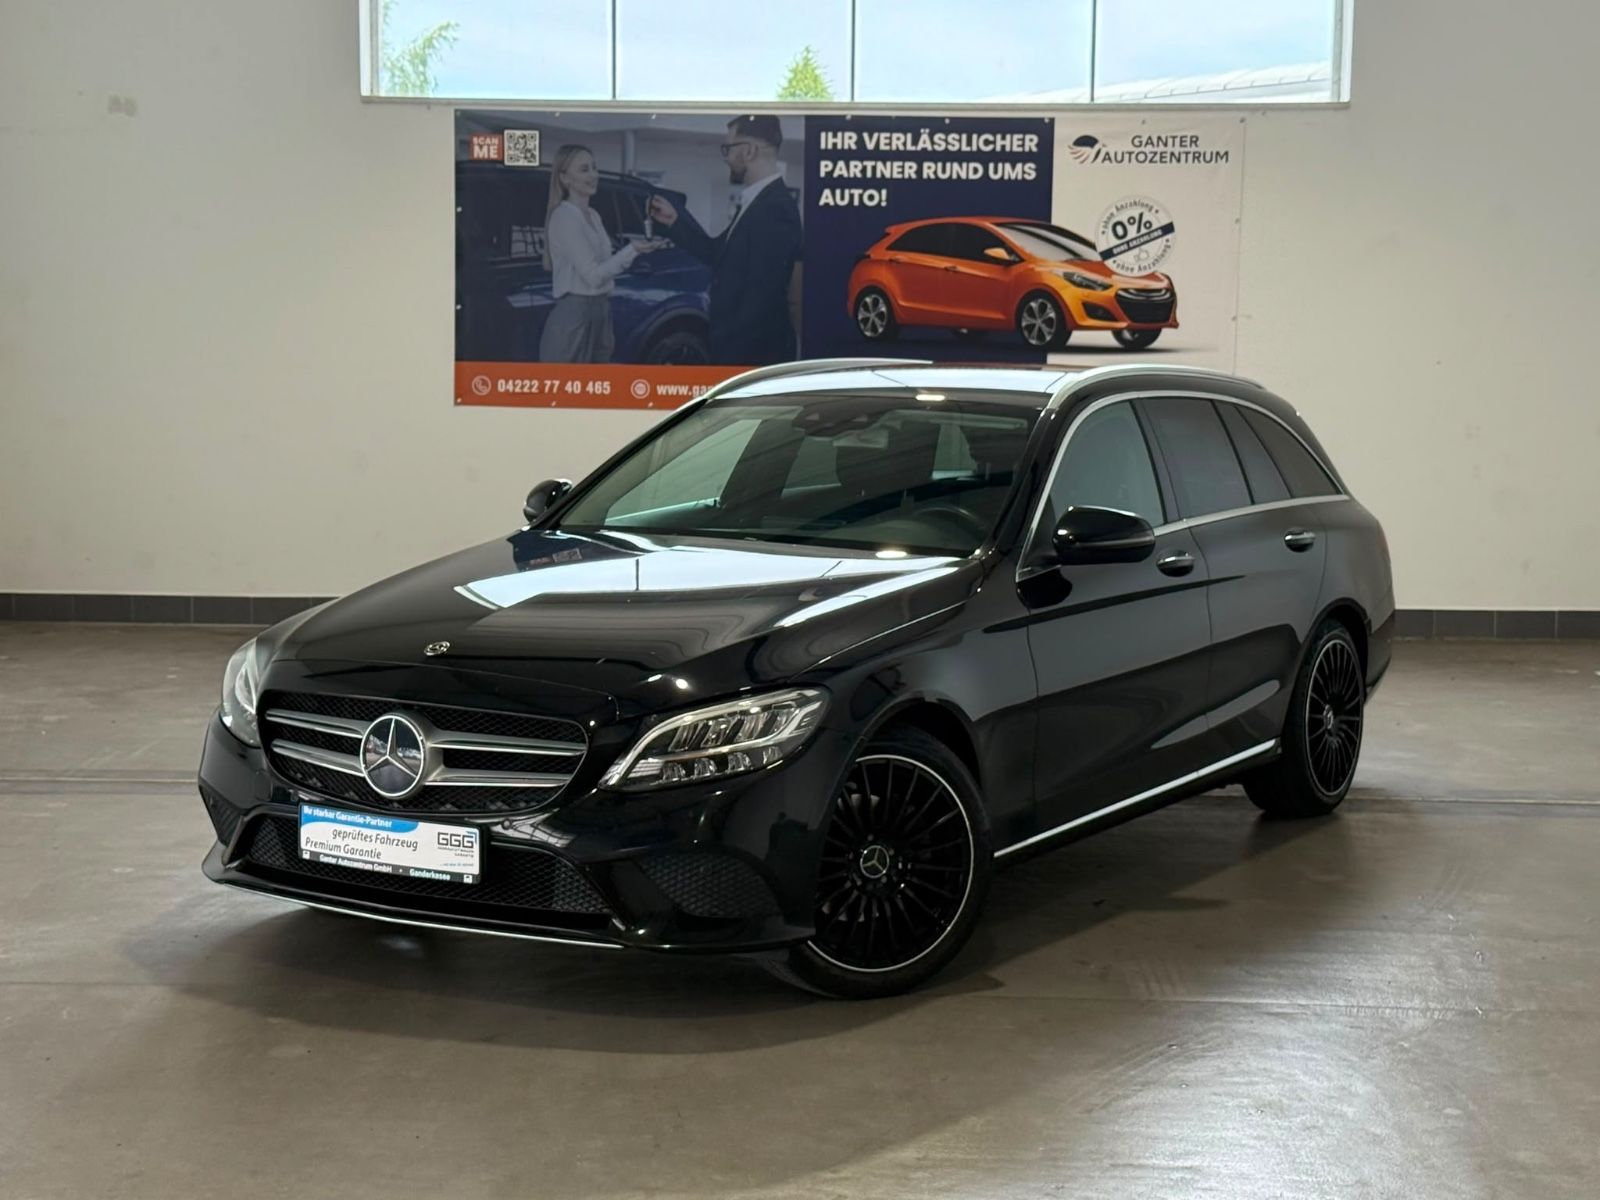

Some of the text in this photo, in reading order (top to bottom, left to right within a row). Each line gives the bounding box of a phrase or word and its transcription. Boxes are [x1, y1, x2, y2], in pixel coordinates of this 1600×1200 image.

[472, 135, 499, 145] SCAN
[819, 128, 1040, 154] IHR VERLÄSSLICHER
[1131, 134, 1200, 149] GANTER
[473, 145, 498, 159] ME
[1102, 149, 1230, 165] AUTOZENTRUM
[819, 160, 1038, 181] PARTNER RUND UMS
[818, 188, 888, 208] AUTO!
[1111, 211, 1153, 241] 0%
[497, 378, 611, 396] 04222 77 40 465
[303, 805, 313, 815] Ihr
[313, 808, 336, 819] starker
[305, 836, 382, 860] Premium Garantie
[332, 828, 419, 852] geprüftes Fahrzeug
[437, 831, 474, 849] GGG
